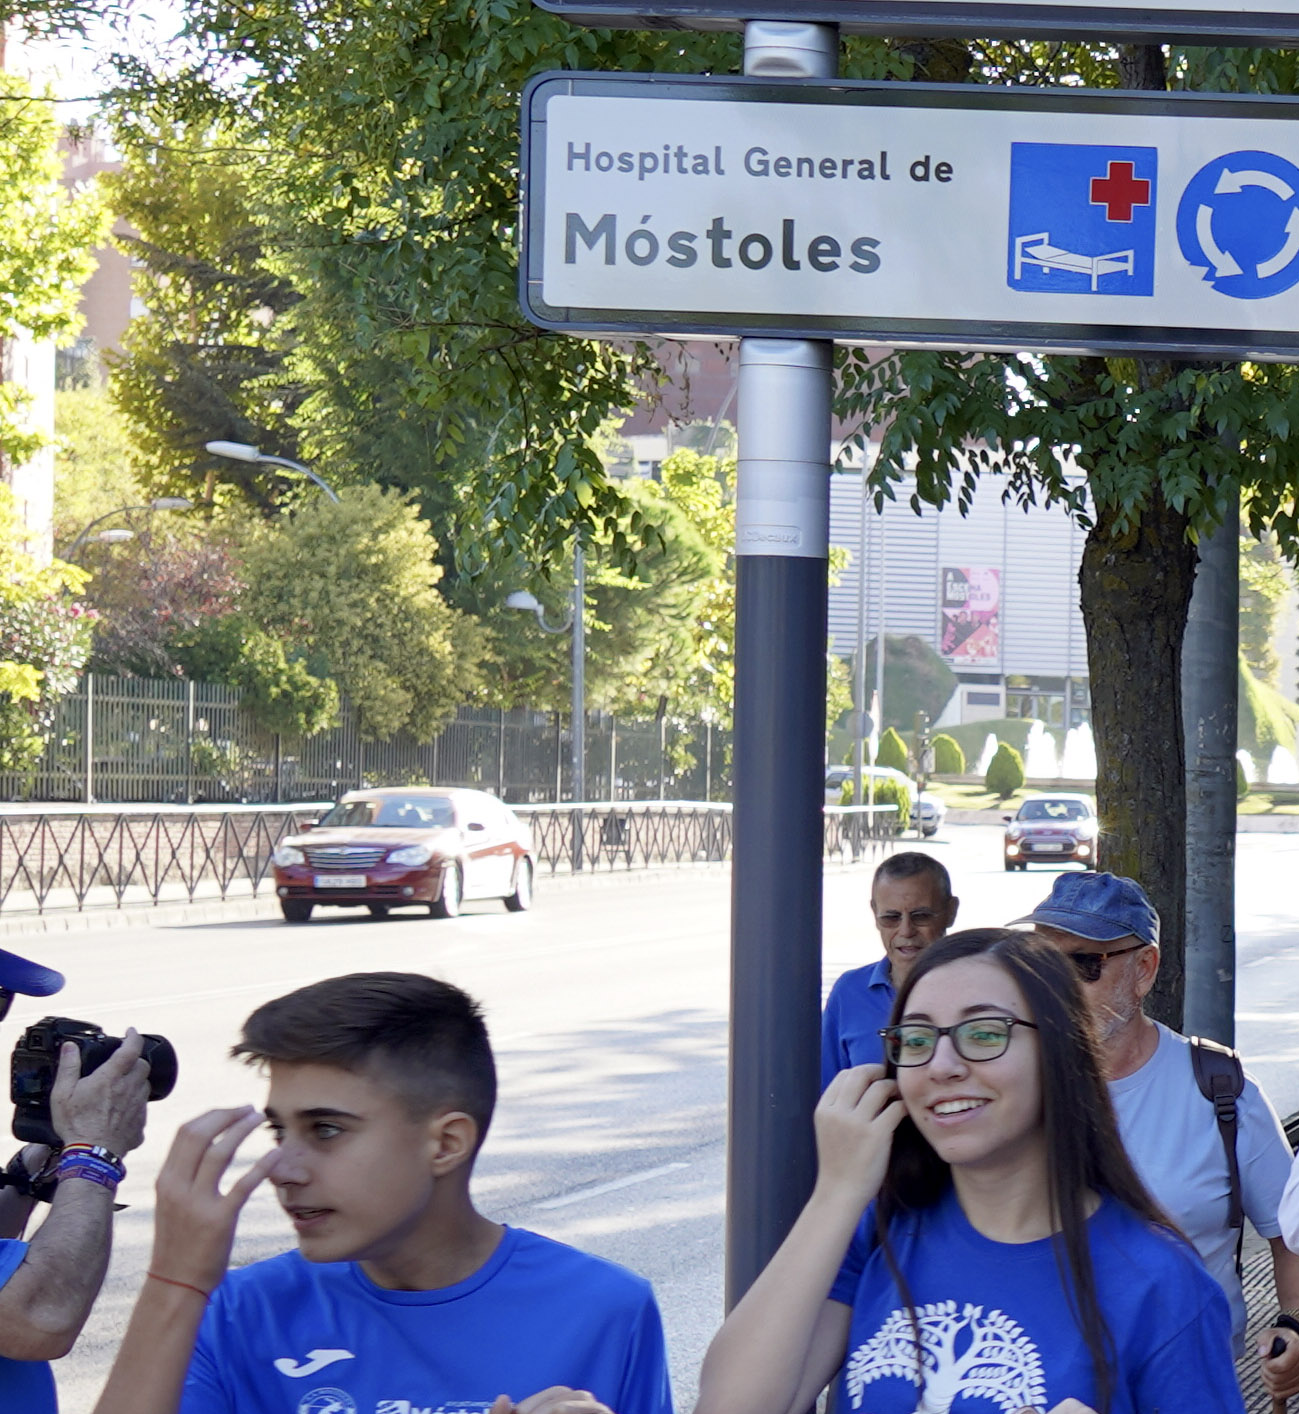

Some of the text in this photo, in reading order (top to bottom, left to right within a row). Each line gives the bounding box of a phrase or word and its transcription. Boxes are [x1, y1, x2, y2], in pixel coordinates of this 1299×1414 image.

[565, 140, 955, 184] Hospital General de
[563, 212, 882, 275] Móstoles
